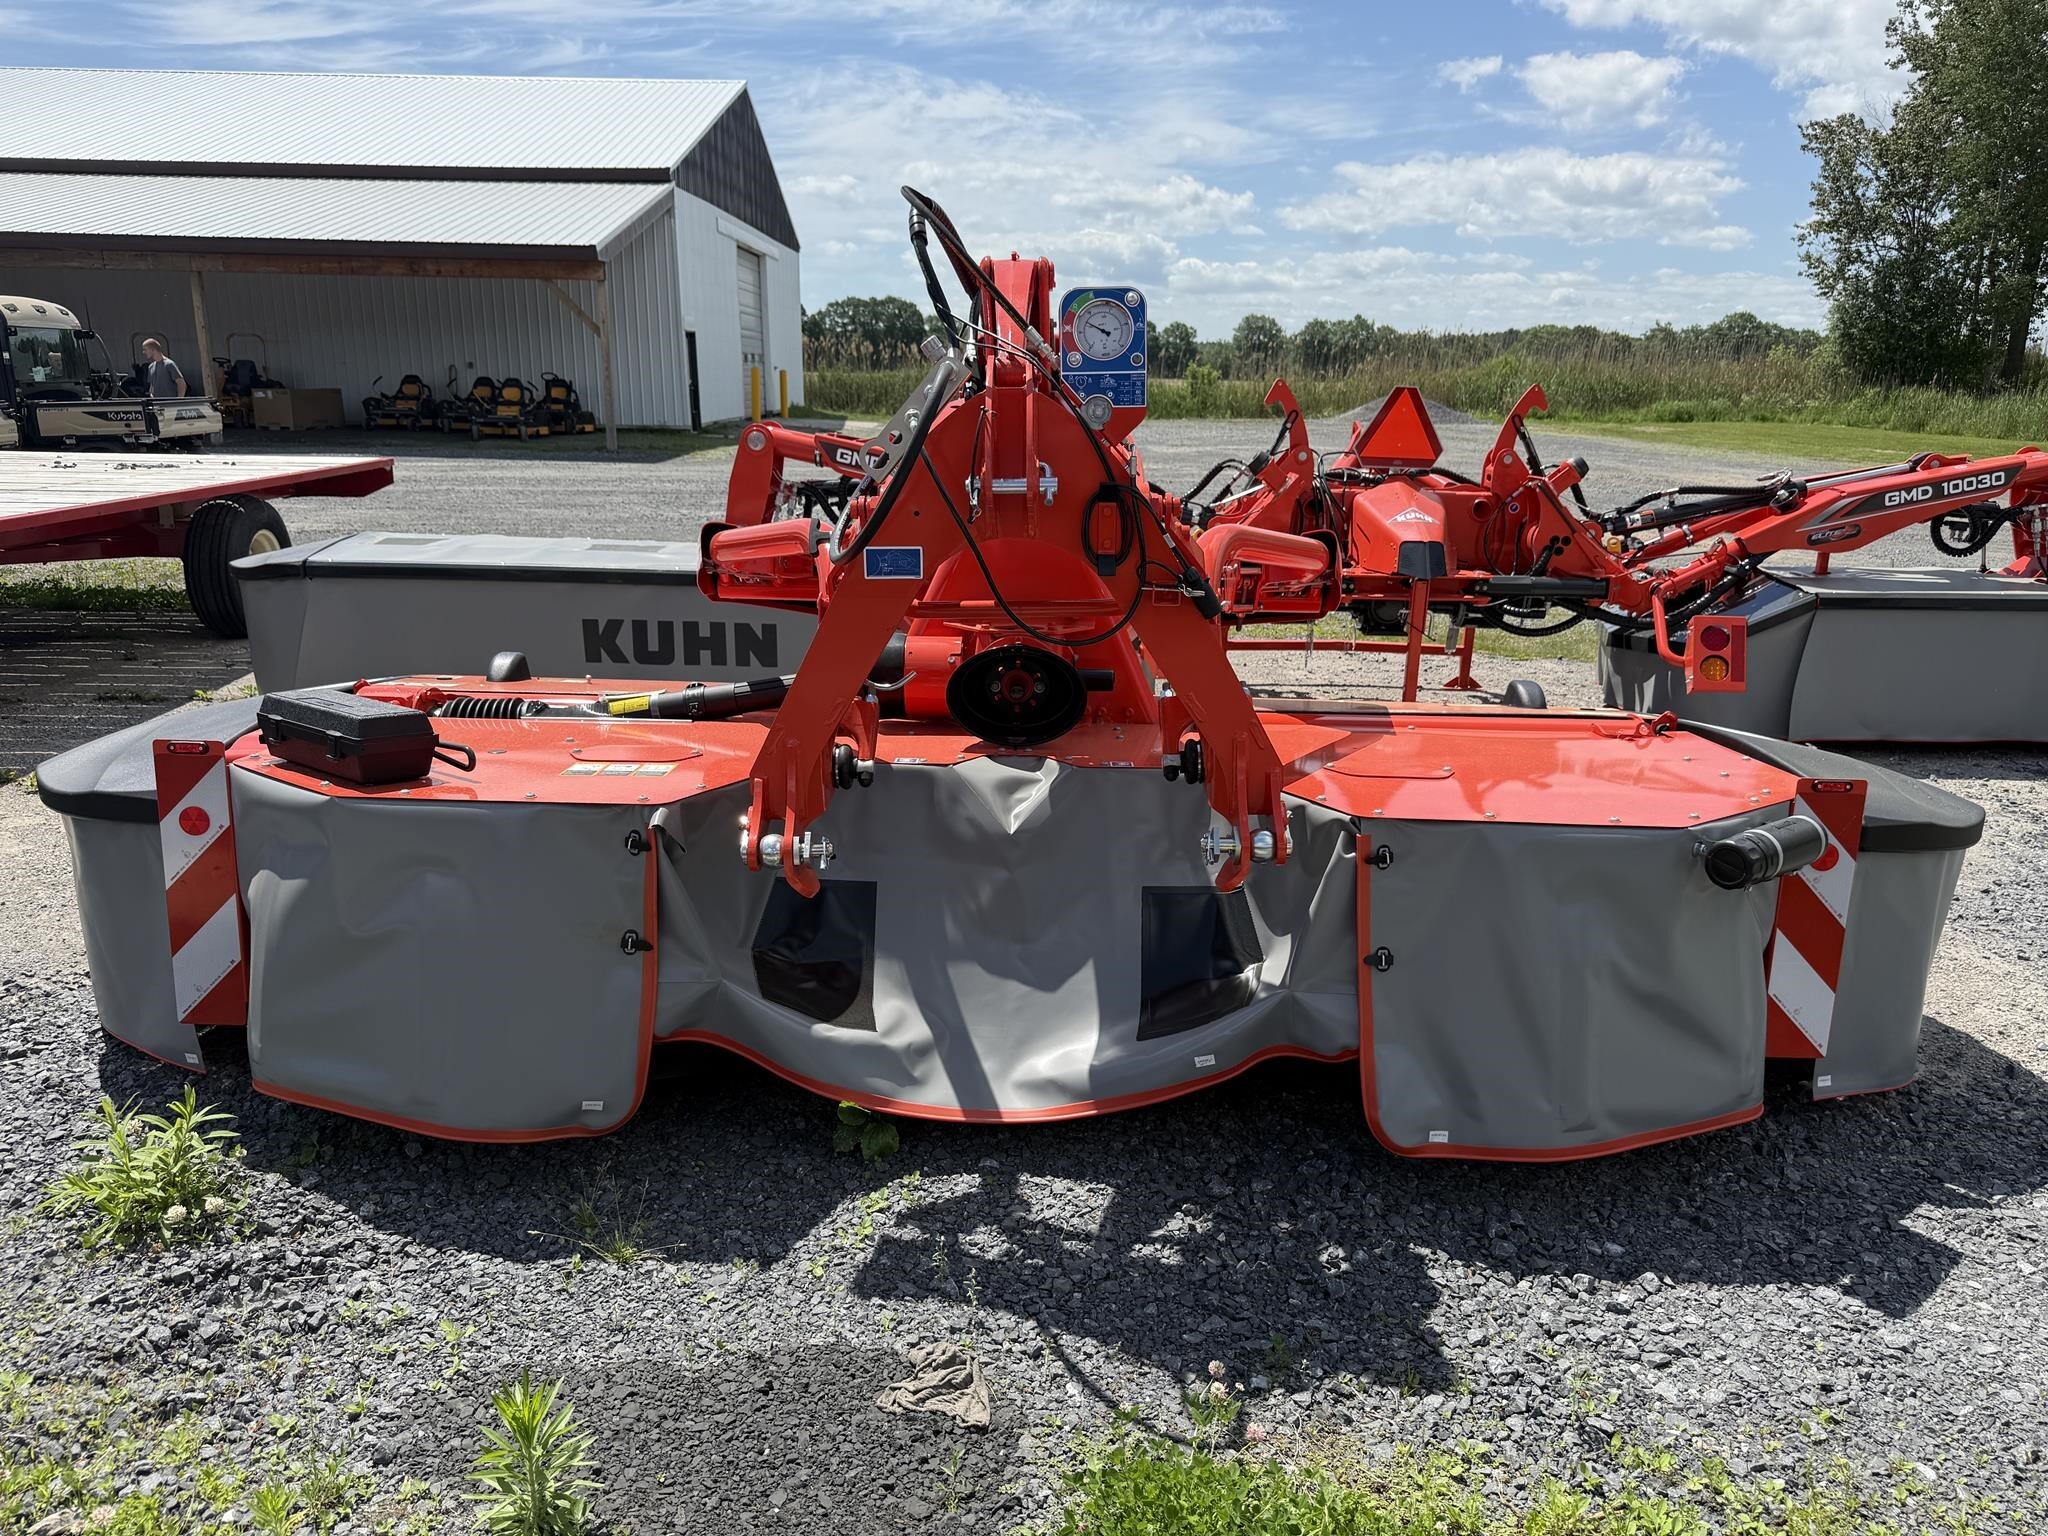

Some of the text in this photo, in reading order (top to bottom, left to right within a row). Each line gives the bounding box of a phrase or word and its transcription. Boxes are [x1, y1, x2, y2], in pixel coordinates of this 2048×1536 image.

[108, 411, 142, 420] Kubota
[1884, 471, 2005, 507] GMD 10030
[1397, 511, 1432, 523] KUHN
[582, 618, 778, 668] KUHN
